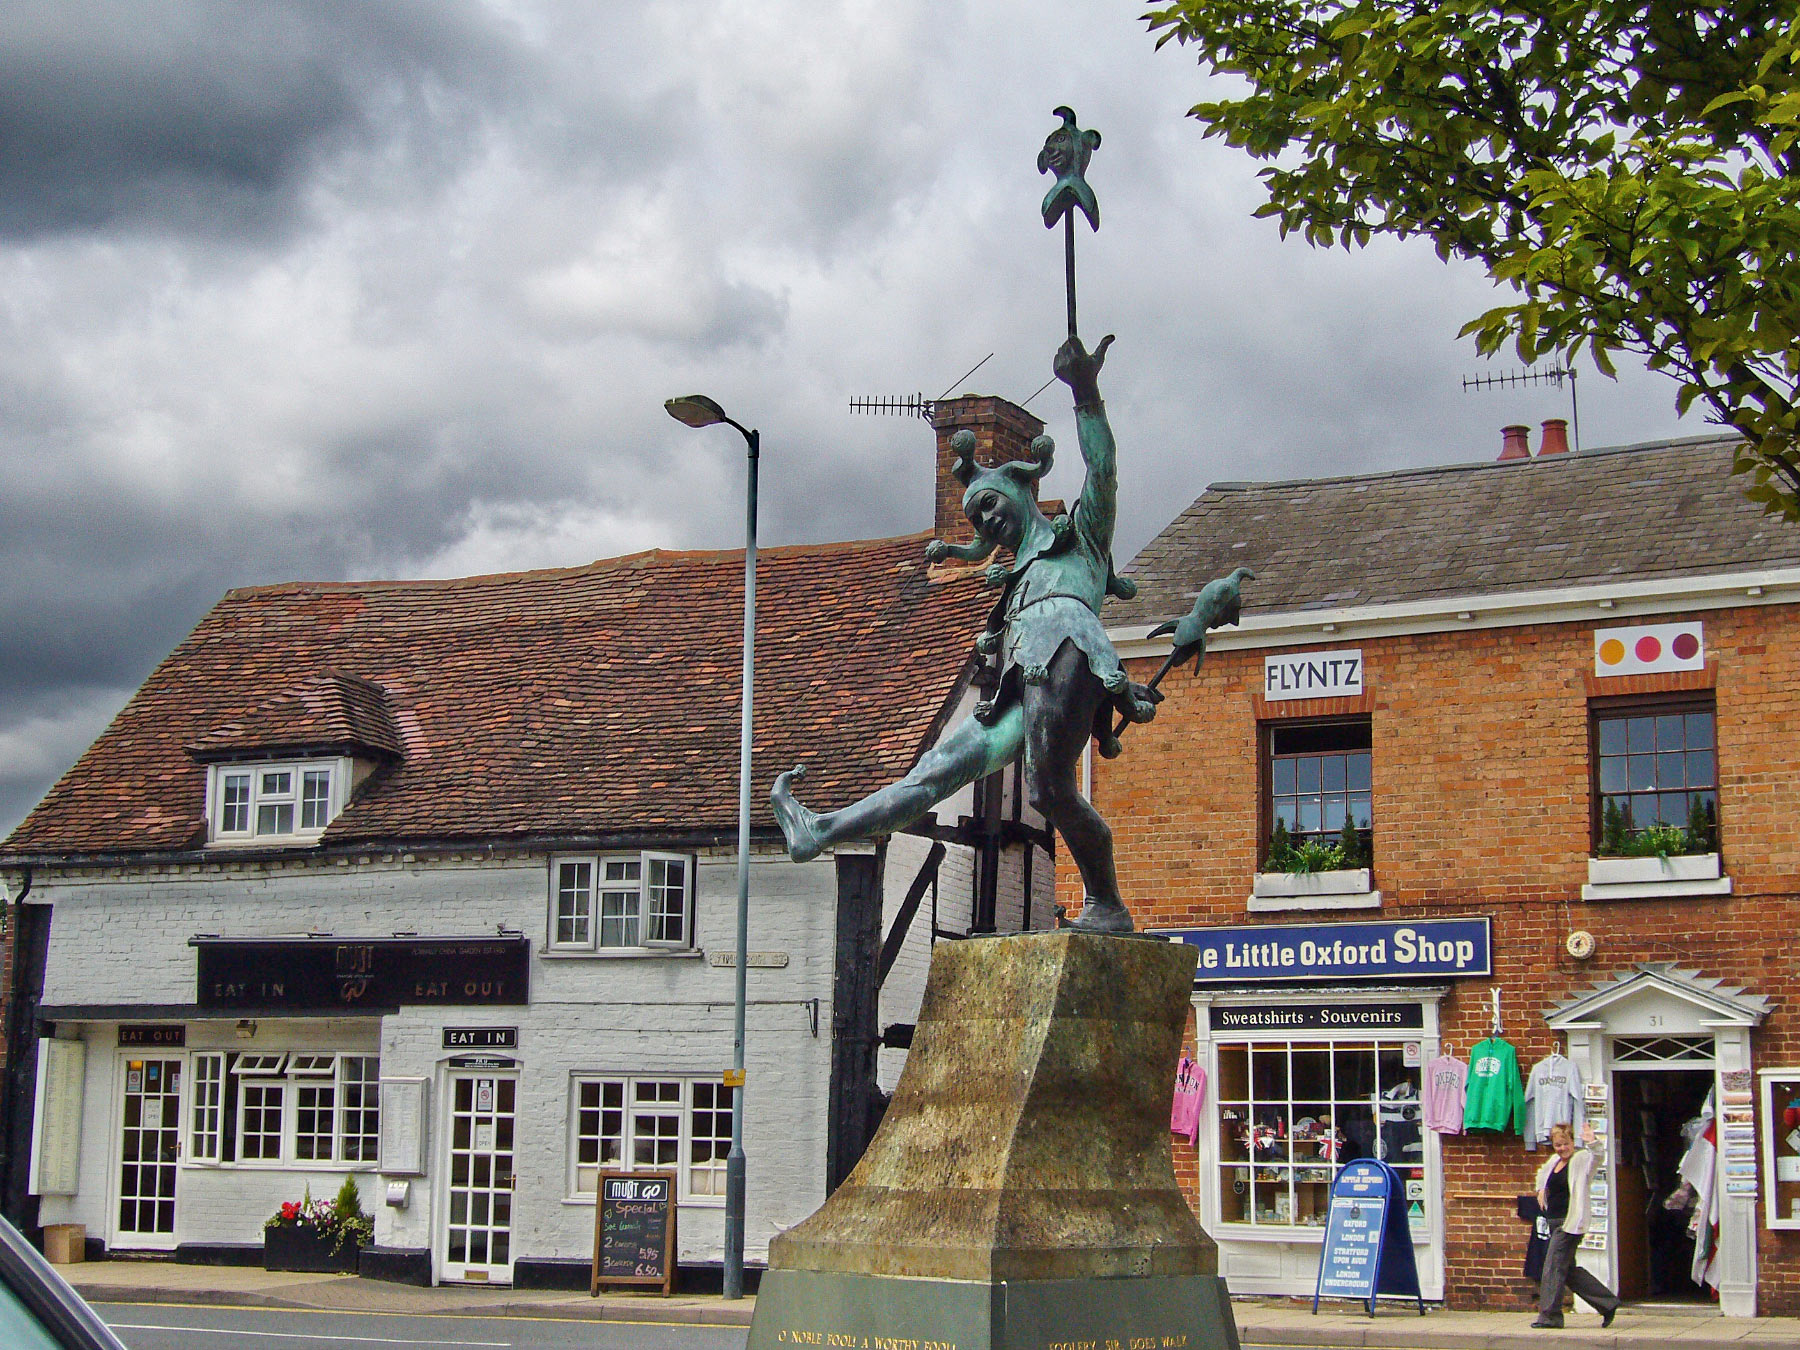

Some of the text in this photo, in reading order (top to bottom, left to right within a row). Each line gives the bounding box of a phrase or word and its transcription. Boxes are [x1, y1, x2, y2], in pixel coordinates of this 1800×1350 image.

[1267, 659, 1360, 691] FLYNTZ
[1225, 943, 1295, 968] Little
[1300, 938, 1387, 966] Oxford
[1393, 928, 1474, 968] Shop
[215, 983, 284, 997] EAT IN
[415, 981, 504, 997] EAT OUT
[1222, 1008, 1402, 1025] Sweatshirts Souvenirs
[1649, 1015, 1663, 1027] 31
[122, 1031, 180, 1041] EAT OUT
[450, 1032, 506, 1044] EAT IN
[611, 1180, 660, 1199] MUST GO
[615, 1201, 658, 1219] Special
[1343, 1220, 1367, 1228] OXFORD
[604, 1236, 613, 1248] 2
[1333, 1248, 1369, 1256] STRATFORD
[603, 1256, 611, 1268] 3
[1333, 1256, 1367, 1265] UPON AVON
[1336, 1270, 1360, 1279] LONDON
[1324, 1278, 1369, 1288] UNDERGROUND
[778, 1330, 787, 1342] O
[792, 1331, 822, 1345] NOBLE
[826, 1333, 856, 1348] FOOL!
[860, 1337, 869, 1349] A
[874, 1336, 919, 1350] WORTHY
[1129, 1337, 1156, 1350] DOES
[1160, 1335, 1187, 1348] WALK
